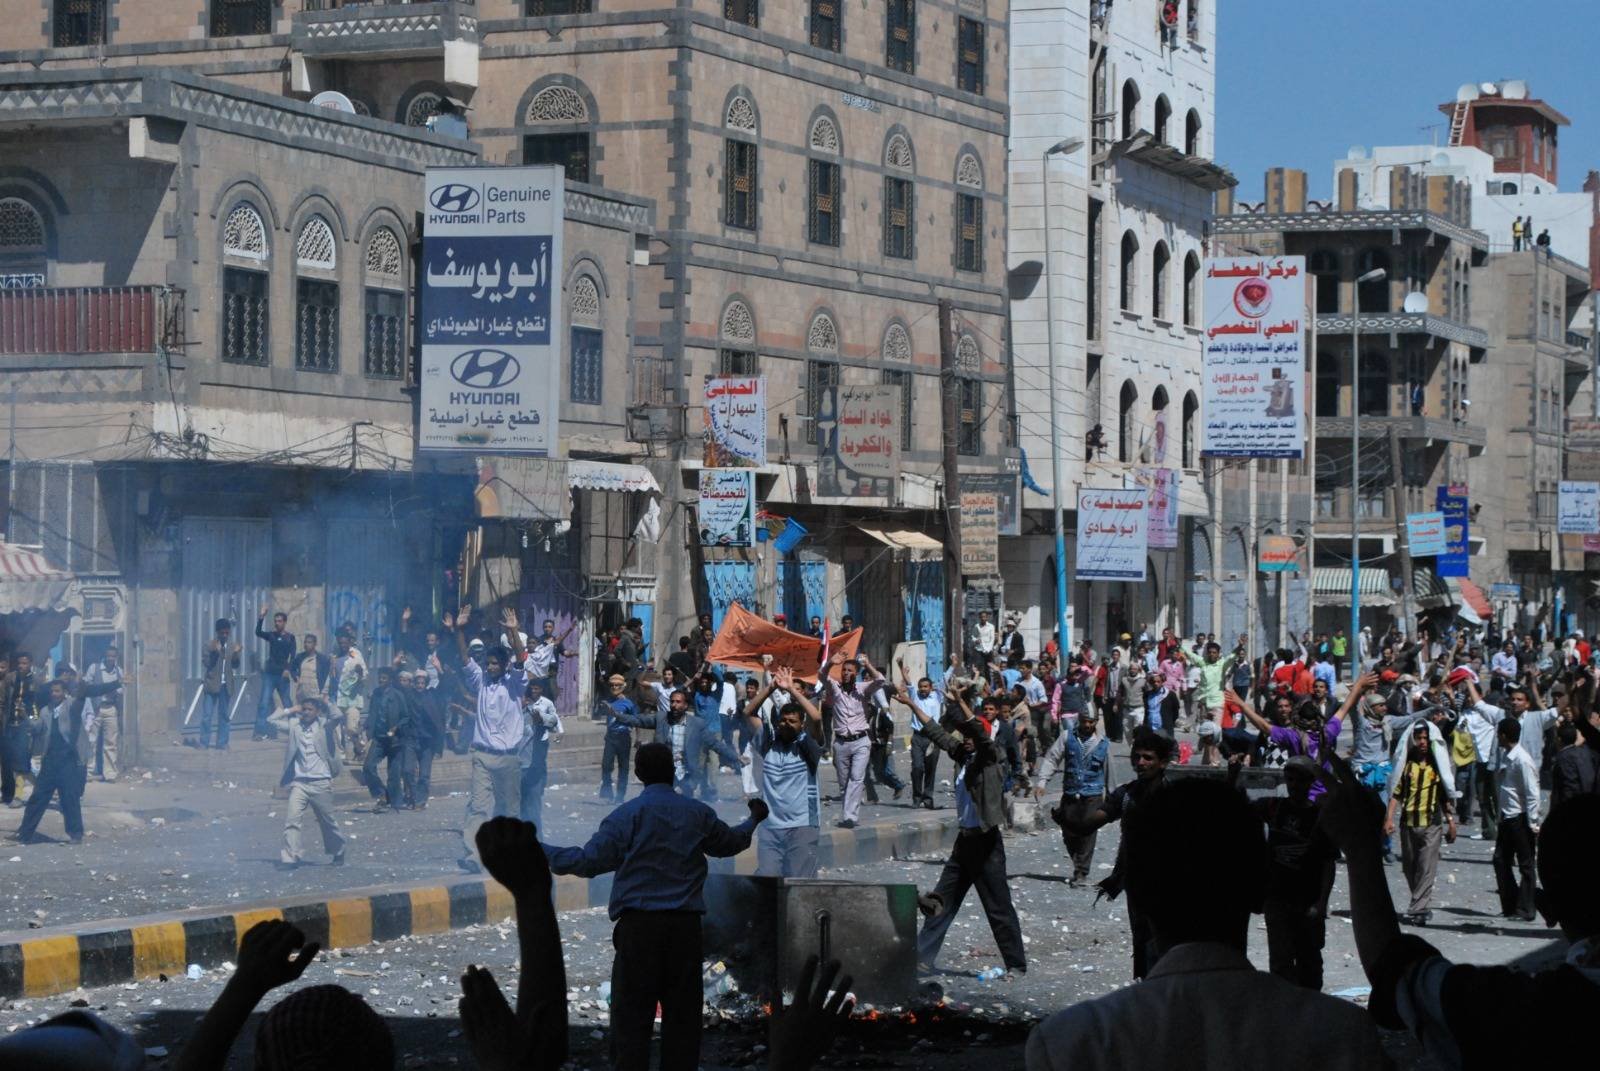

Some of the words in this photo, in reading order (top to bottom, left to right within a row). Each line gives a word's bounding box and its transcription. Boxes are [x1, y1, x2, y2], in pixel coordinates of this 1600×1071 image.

[487, 186, 551, 202] Genuine
[429, 214, 480, 224] HYUNDAI
[487, 209, 526, 224] Parts
[426, 247, 503, 303] يوسف
[503, 242, 547, 303] أبو
[1207, 261, 1264, 278] العطاء
[1265, 260, 1298, 280] مركز
[426, 316, 485, 338] الهيونداي
[485, 316, 513, 336] غيار
[515, 316, 546, 338] لقطع
[1207, 320, 1261, 341] التخصصي
[1264, 320, 1299, 340] الطبي
[449, 392, 520, 405] HYUNDAI
[429, 409, 469, 428] أصلية
[471, 410, 505, 429] غيار
[508, 410, 540, 430] قطع
[839, 408, 867, 428] البناء
[839, 435, 892, 458] والكهرباء
[717, 472, 742, 485] ناصر
[1093, 495, 1144, 513] صيدلية
[1084, 520, 1117, 539] هادي
